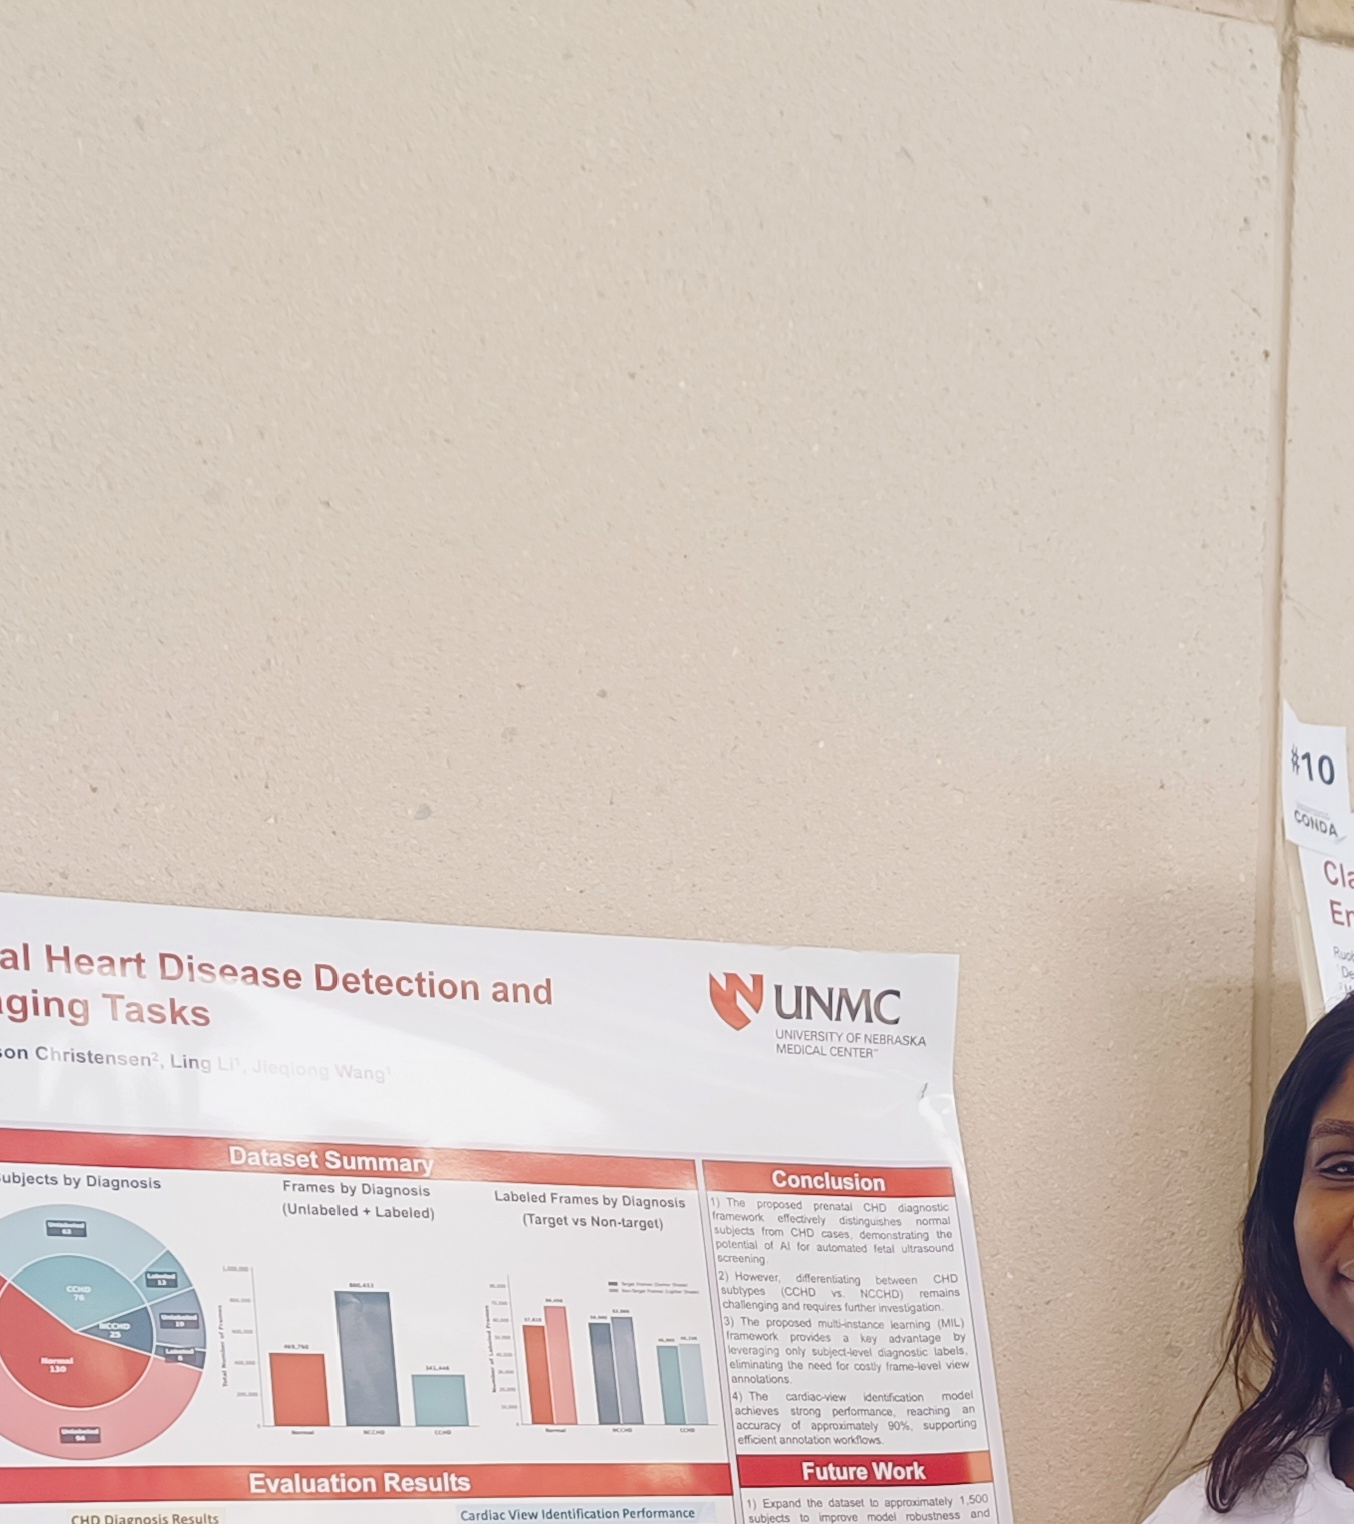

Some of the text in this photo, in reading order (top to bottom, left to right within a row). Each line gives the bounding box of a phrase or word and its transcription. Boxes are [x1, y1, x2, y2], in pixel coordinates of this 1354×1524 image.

[1291, 744, 1335, 785] #10
[1294, 810, 1338, 838] CONDA
[45, 945, 145, 979] Heart
[159, 953, 302, 989] Disease
[315, 964, 479, 1001] Detection
[492, 978, 552, 1005] and
[102, 993, 210, 1027] Tasks
[774, 985, 900, 1025] UNMC
[776, 1029, 926, 1046] UNIVERSITY OF NEBRASKA
[776, 1044, 827, 1055] MEDICAL
[170, 1054, 211, 1073] Ling
[230, 1146, 434, 1176] Dataset Summary
[283, 1181, 431, 1199] Frames by Diagnosis
[772, 1170, 885, 1192] Conclusion
[282, 1202, 435, 1221] (Unlabeled Labeled)
[494, 1190, 686, 1212] Labeled Frames by Diagnosis
[523, 1213, 663, 1231] (Target vs Non-target)
[802, 1461, 926, 1481] Future Work
[249, 1472, 470, 1494] Evaluation Results
[461, 1507, 695, 1521] Cardiac View Identification Performance
